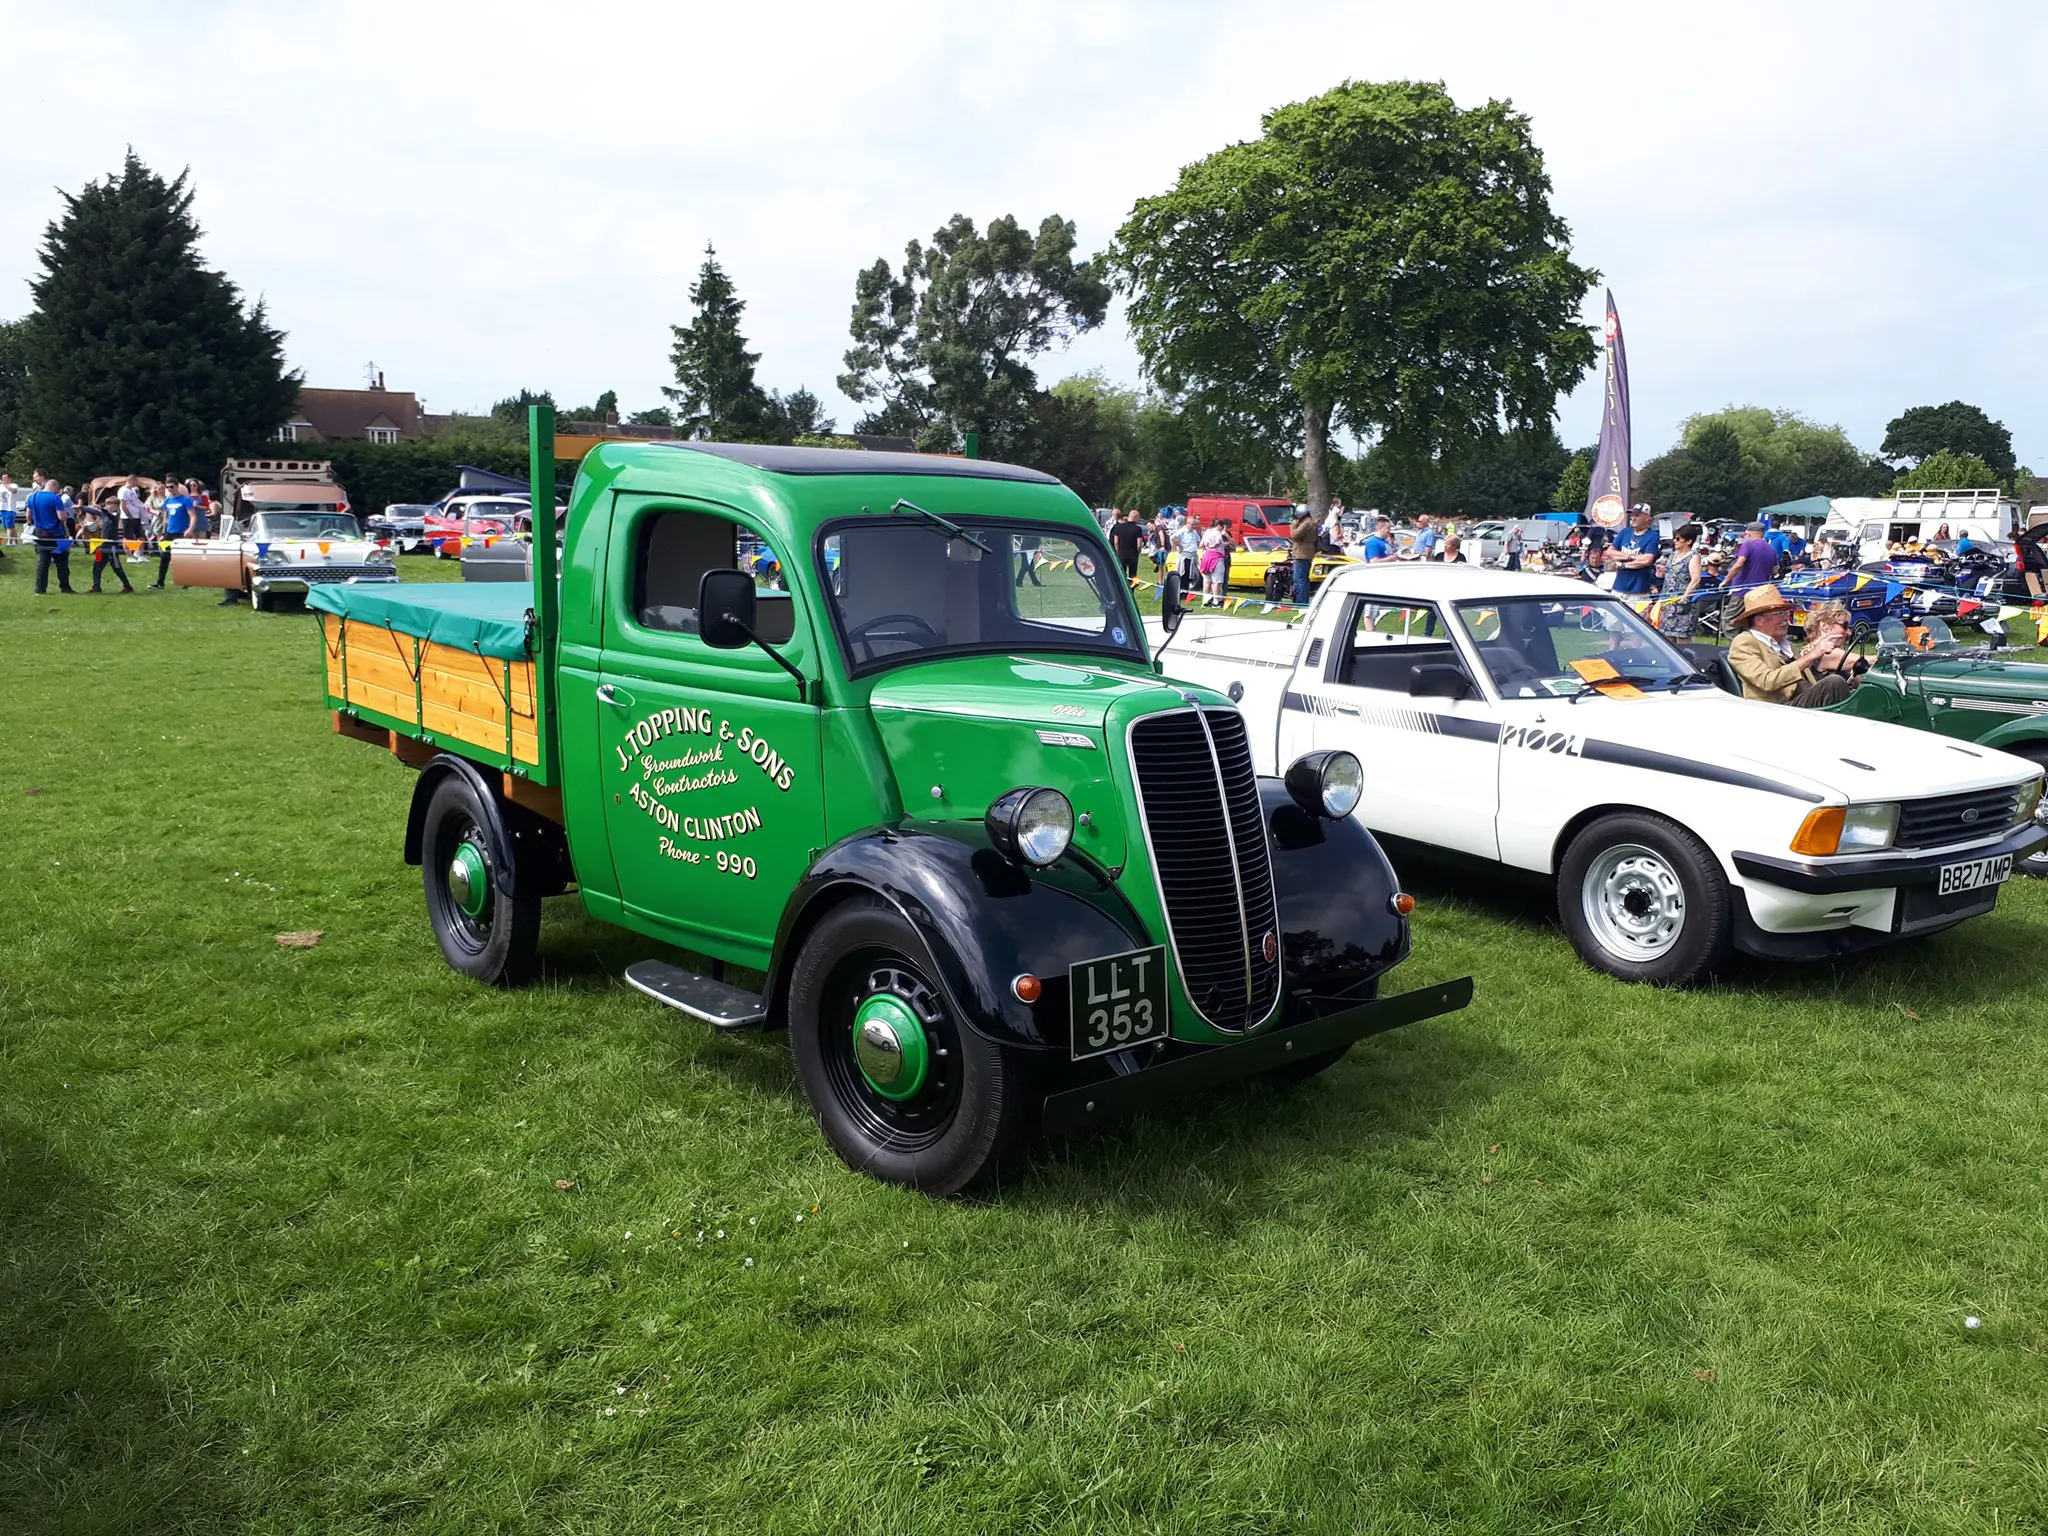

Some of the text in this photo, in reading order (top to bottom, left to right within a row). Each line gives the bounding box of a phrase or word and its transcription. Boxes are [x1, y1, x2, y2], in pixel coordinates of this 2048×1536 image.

[616, 707, 795, 791] J. TOPPING & SONS
[641, 743, 724, 780] Groundwork
[1502, 725, 1578, 757] P100L
[653, 768, 739, 797] Contractors
[629, 782, 763, 840] ASTON CLINTON
[659, 836, 700, 864] Phone
[716, 851, 757, 879] 990
[1941, 856, 2011, 893] B827 AMP
[1087, 955, 1151, 1005] LLT
[1088, 998, 1153, 1047] 353
